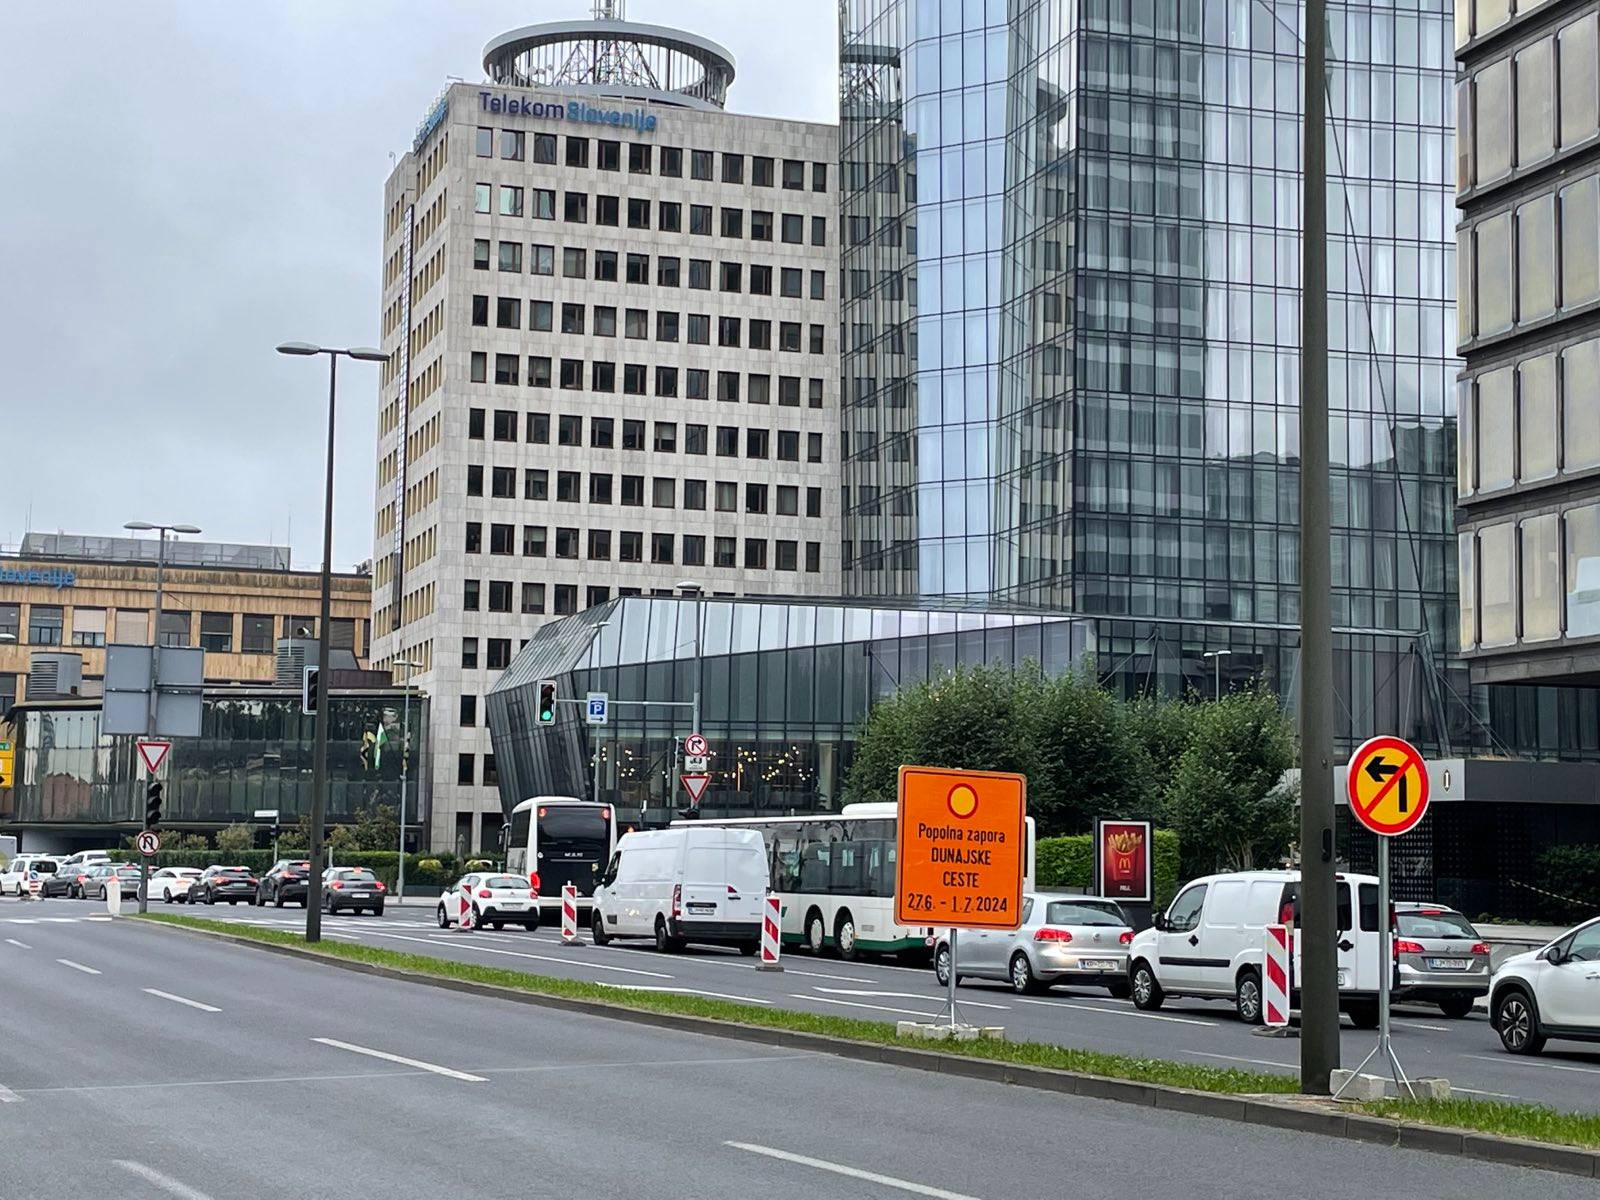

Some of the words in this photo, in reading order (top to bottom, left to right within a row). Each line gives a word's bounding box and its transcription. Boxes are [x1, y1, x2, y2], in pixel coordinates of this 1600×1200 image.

[918, 823, 963, 842] Popolna
[967, 829, 1005, 845] zapora
[931, 847, 991, 865] DUNAJSKE
[943, 871, 979, 888] CESTE
